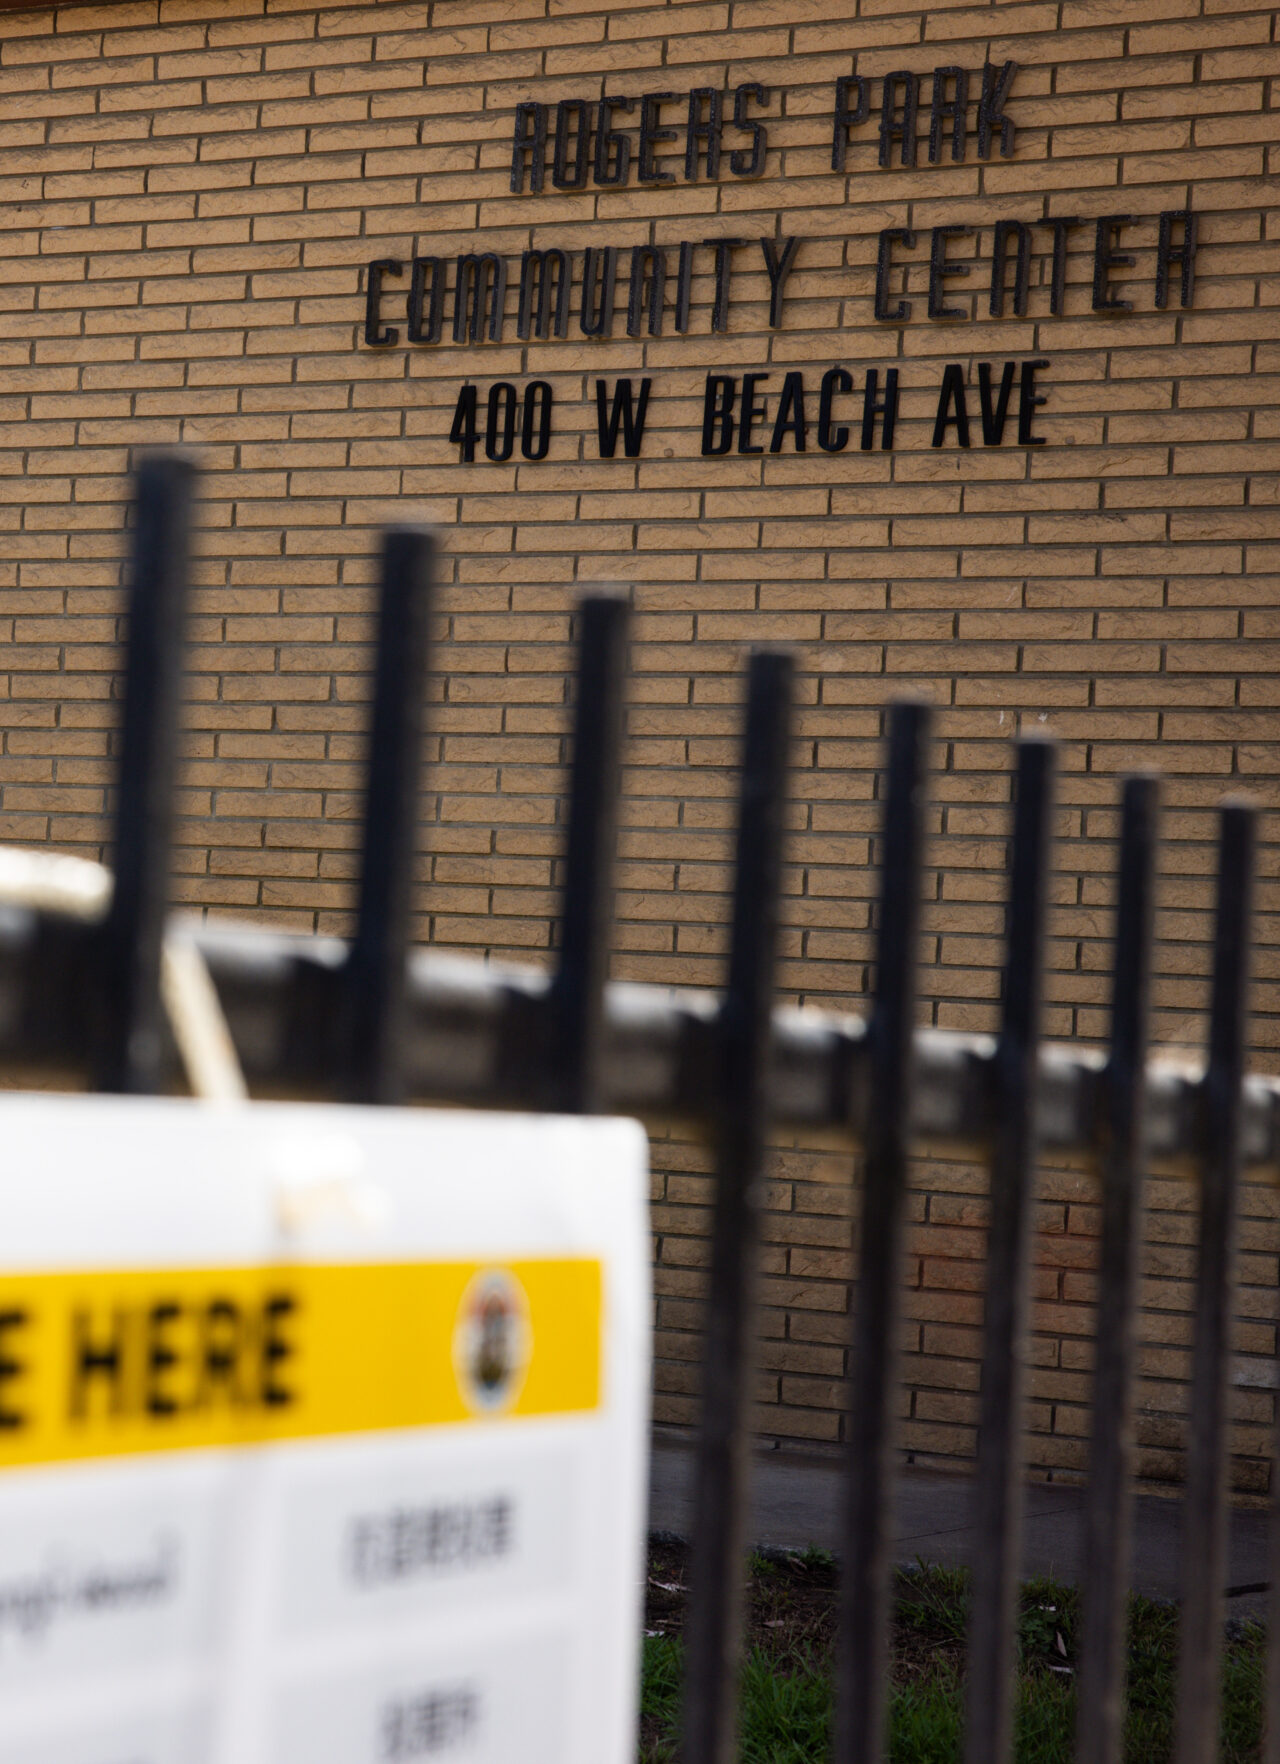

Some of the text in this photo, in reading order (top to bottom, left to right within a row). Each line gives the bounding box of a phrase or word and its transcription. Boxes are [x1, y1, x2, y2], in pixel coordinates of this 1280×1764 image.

[510, 60, 1019, 193] ROGERS PARK
[363, 210, 1198, 348] COMMUNITY CENTER
[448, 359, 1051, 463] 400 W BEACH AVE
[66, 1287, 300, 1430] HERE
